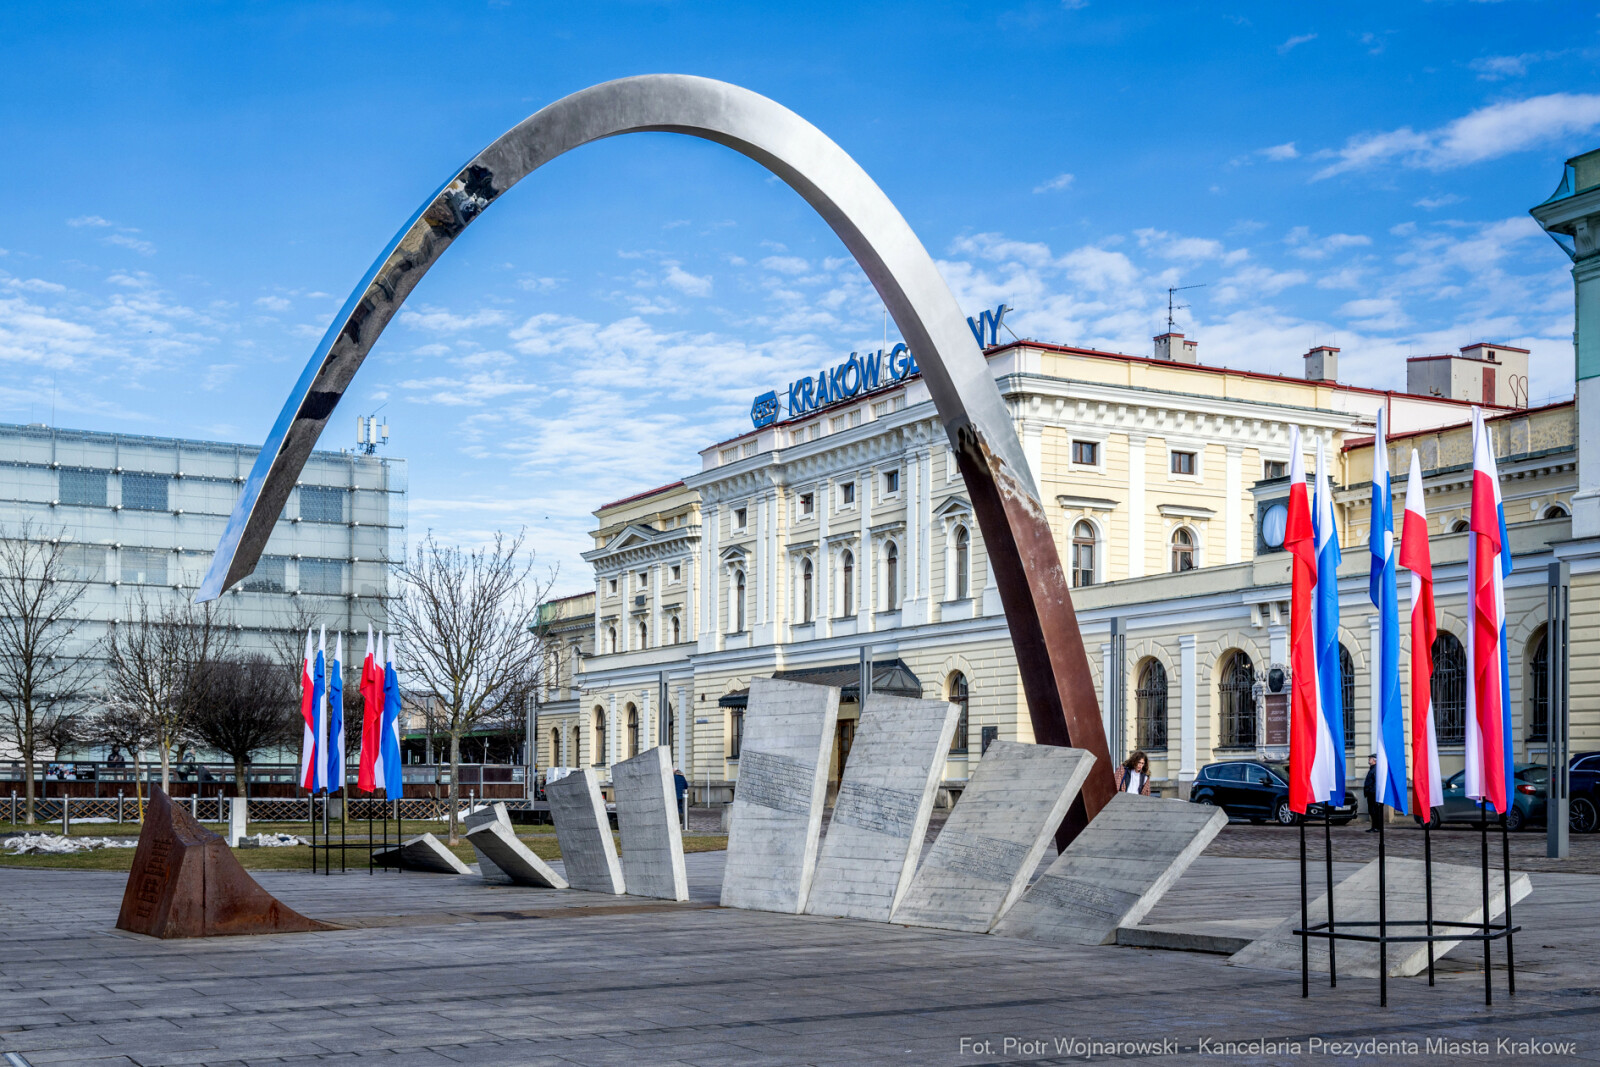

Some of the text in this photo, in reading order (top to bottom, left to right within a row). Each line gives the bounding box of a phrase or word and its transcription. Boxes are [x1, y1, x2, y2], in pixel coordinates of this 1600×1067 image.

[789, 304, 1006, 417] KRAKÓW GŁNY
[752, 399, 777, 419] PKP
